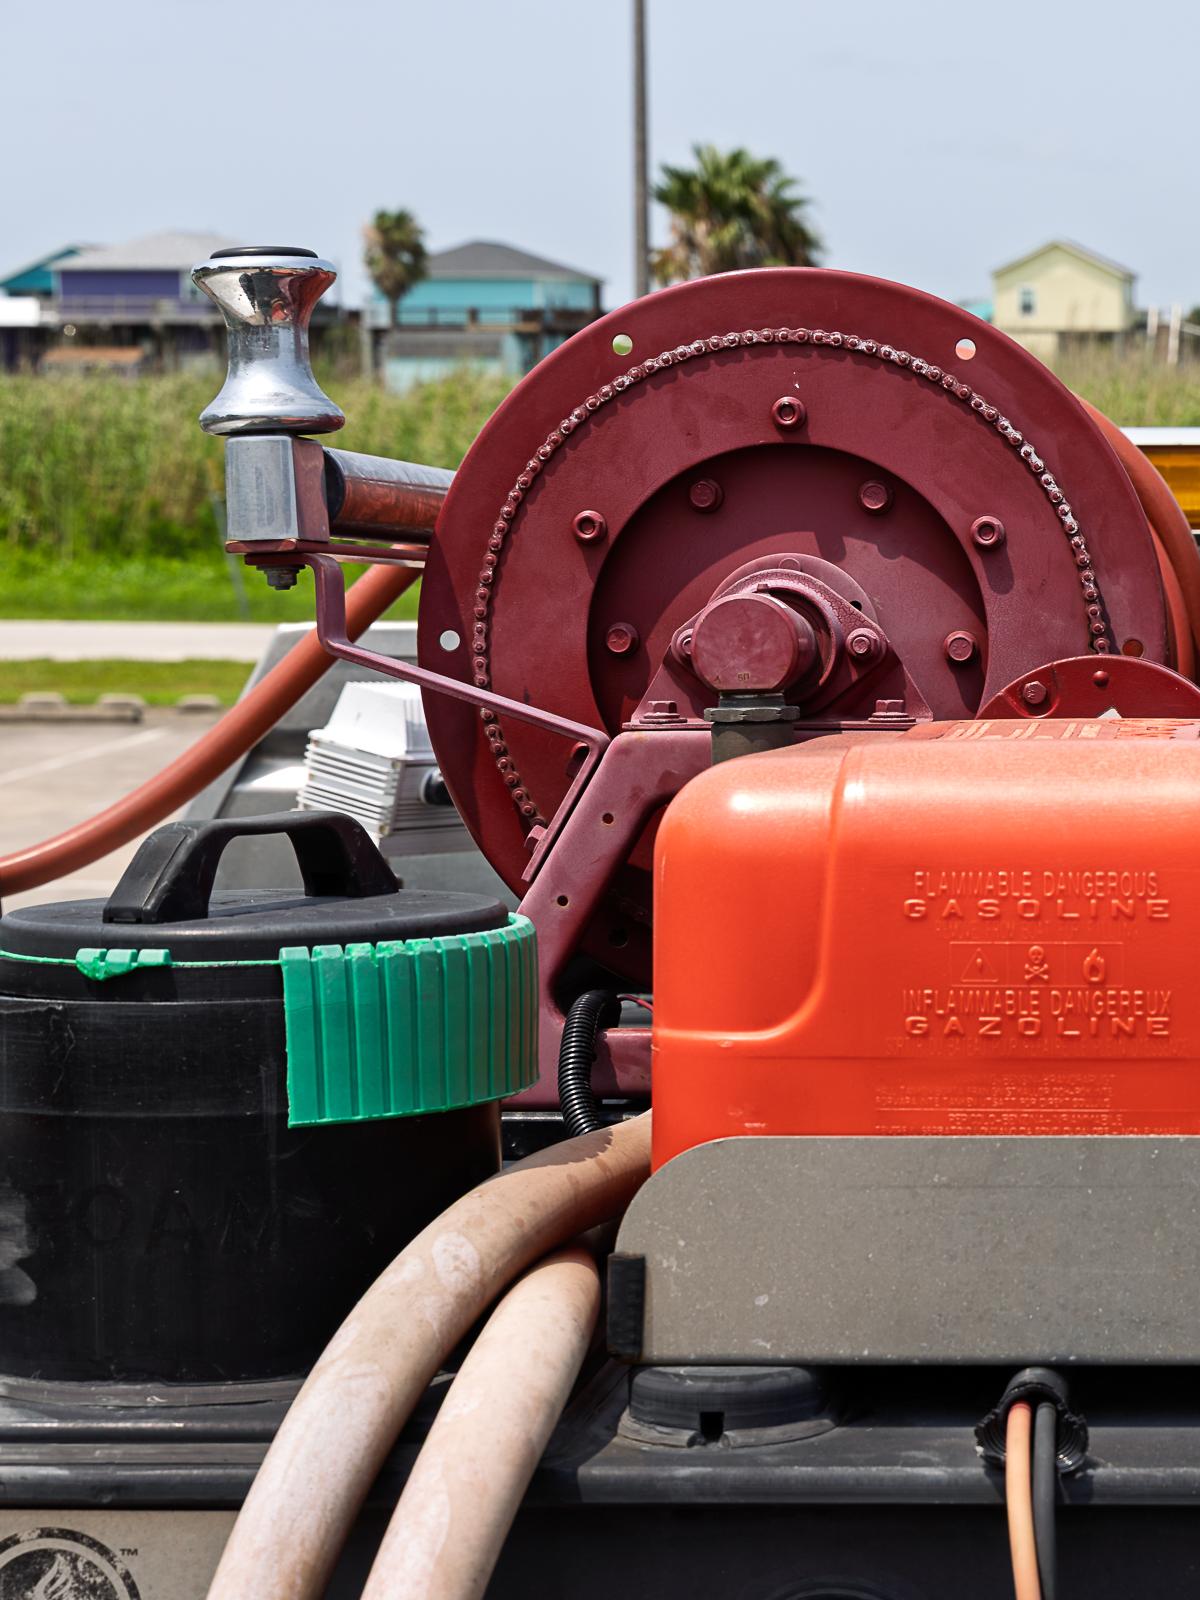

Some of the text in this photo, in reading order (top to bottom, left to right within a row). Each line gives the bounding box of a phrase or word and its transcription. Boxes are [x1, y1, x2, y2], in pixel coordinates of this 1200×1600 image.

[914, 871, 1158, 897] FLAMMABLE DANGEROUS
[903, 898, 1170, 919] GASOLINE
[902, 989, 1172, 1015] INFLAMMABLE DANGEREUX
[904, 1015, 1170, 1036] GAZOLINE
[120, 1548, 138, 1556] TM
